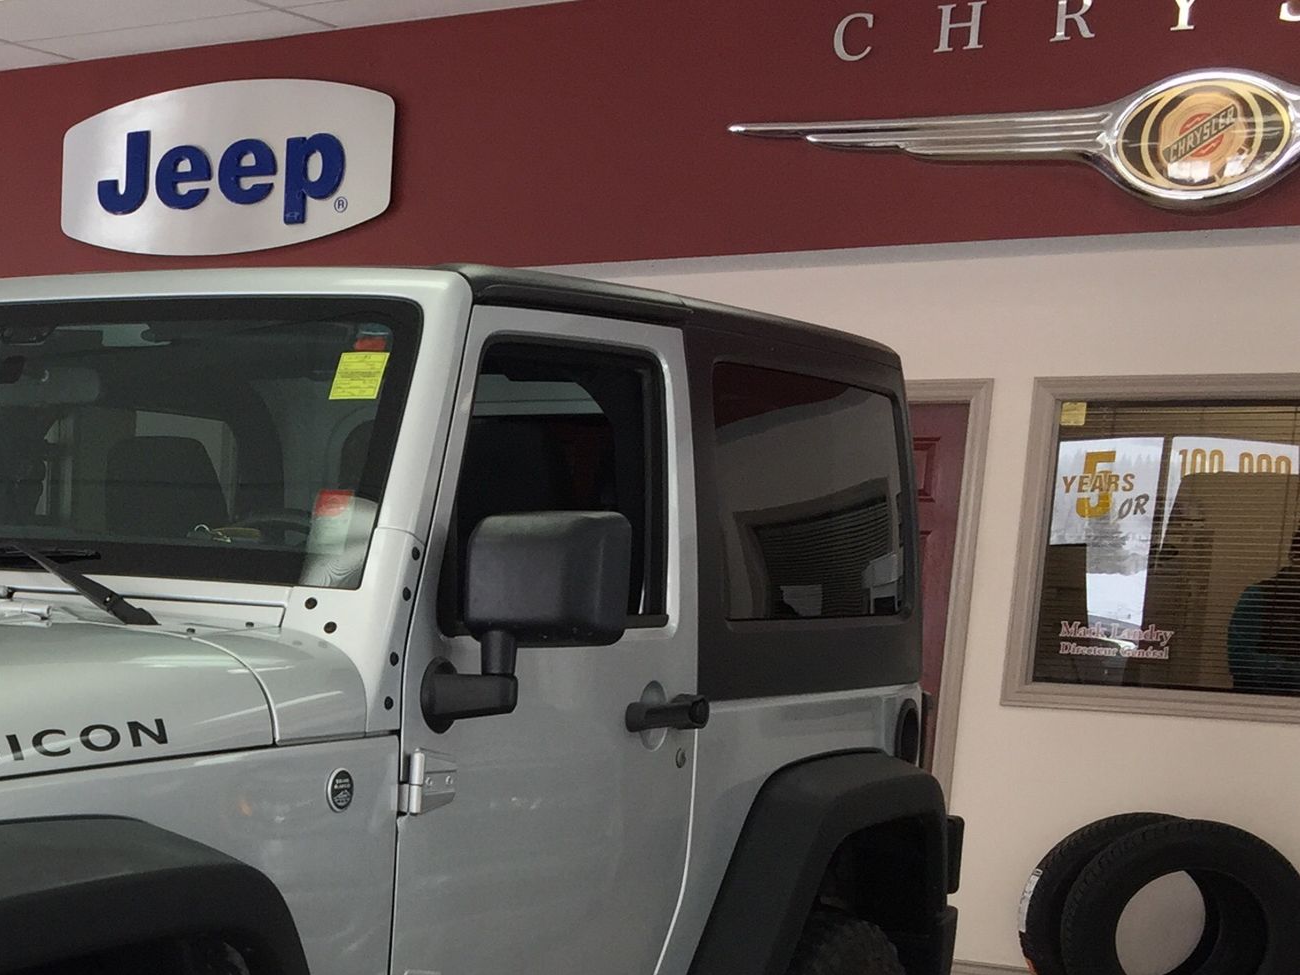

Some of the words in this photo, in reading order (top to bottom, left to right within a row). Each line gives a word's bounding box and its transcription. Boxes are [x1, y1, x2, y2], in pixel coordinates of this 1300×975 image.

[1170, 106, 1236, 159] CHRYSLER
[97, 130, 346, 225] Jeep
[1062, 473, 1136, 493] YEARS
[1076, 450, 1116, 519] 5
[1117, 494, 1149, 521] OR
[1109, 623, 1175, 646] Landry
